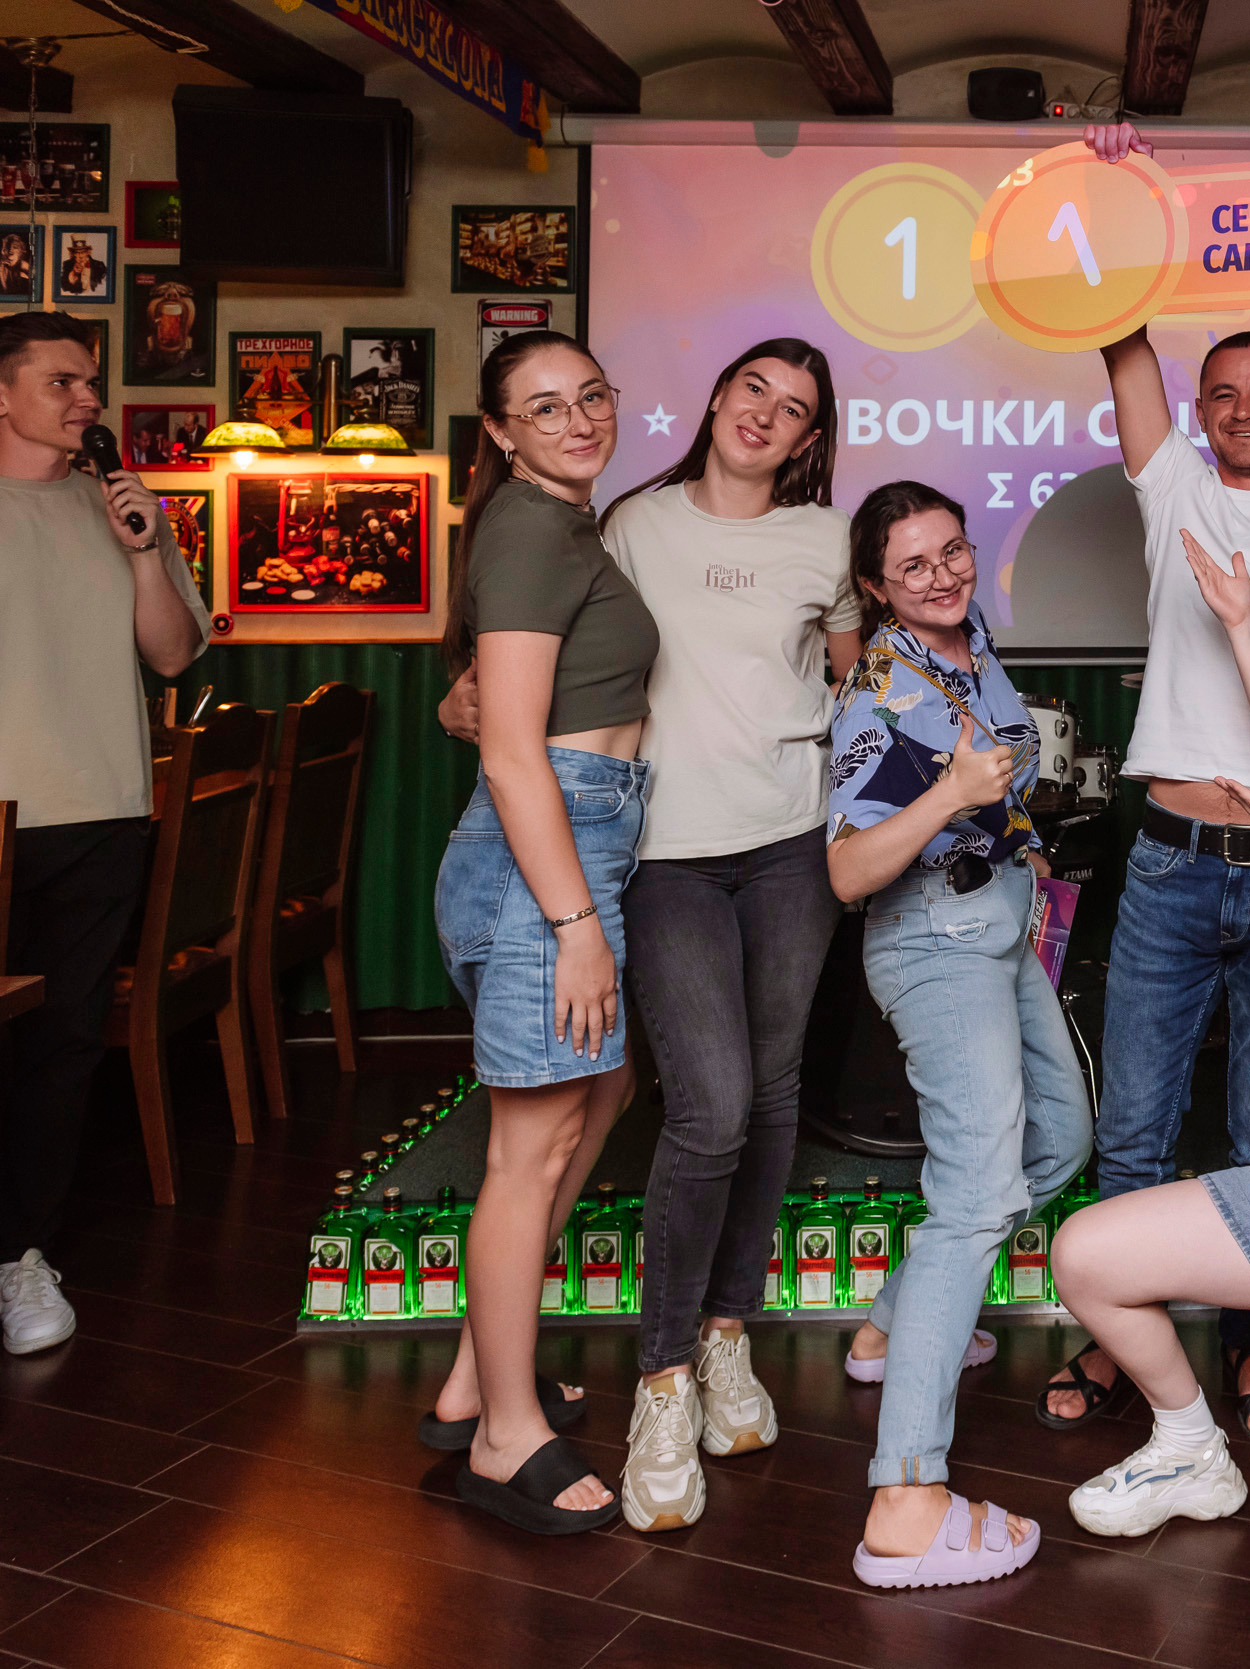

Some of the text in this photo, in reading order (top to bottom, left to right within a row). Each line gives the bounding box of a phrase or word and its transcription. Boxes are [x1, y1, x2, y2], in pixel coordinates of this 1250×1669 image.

[1047, 202, 1102, 286] 1
[884, 217, 918, 299] 1
[490, 309, 539, 321] WARNING
[238, 339, 313, 351] ТРЕХГОРНОЕ
[835, 398, 1066, 446] ВОЧКИ
[719, 567, 735, 575] the
[705, 568, 758, 593] light
[1070, 868, 1094, 880] TAMA
